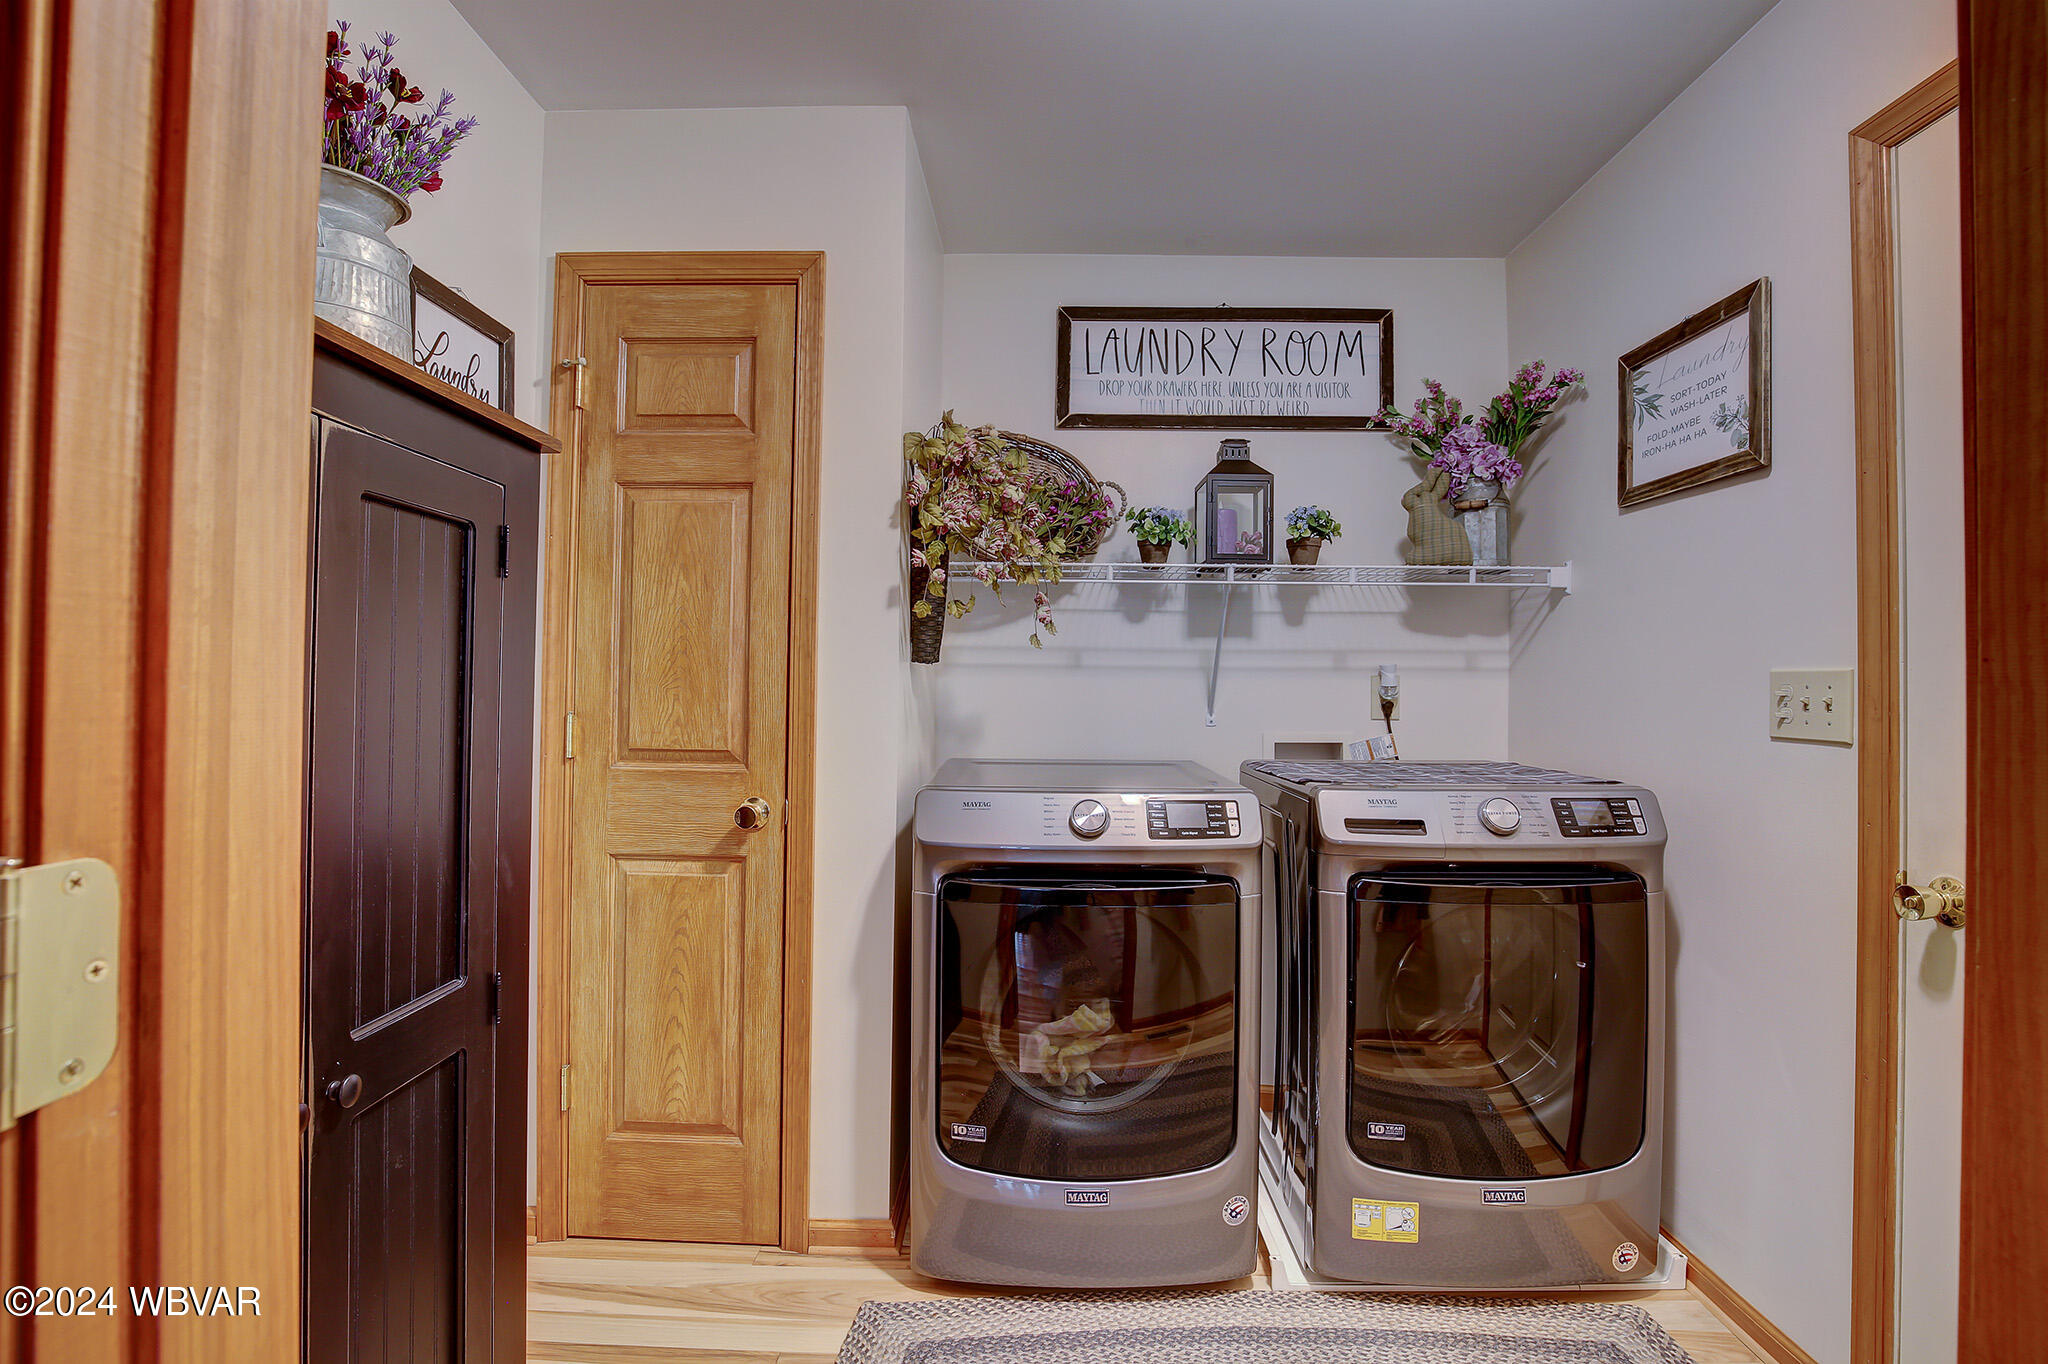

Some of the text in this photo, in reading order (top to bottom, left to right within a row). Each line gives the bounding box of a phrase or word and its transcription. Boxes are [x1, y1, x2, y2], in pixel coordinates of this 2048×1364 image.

[1085, 326, 1366, 377] LAUNDRY ROOM
[1656, 325, 1749, 389] Laundry
[1099, 379, 1352, 399] DROP YOUR DRAWERS HERE. UNLESS YOU ARE A VISITOR
[1670, 370, 1727, 403] SORT-TODAY
[1170, 398, 1181, 415] IT
[1185, 399, 1224, 415] WOULD
[1228, 399, 1256, 415] JUST
[1276, 400, 1310, 416] WEIRD
[1669, 385, 1728, 417] WASH-LATER
[1646, 415, 1702, 444] FOLD-MAYBE
[1641, 427, 1708, 459] IRON-HA HA HA
[953, 1125, 967, 1135] 10
[1370, 1124, 1385, 1134] 10
[1067, 1192, 1107, 1203] MAYTAG
[1484, 1191, 1524, 1201] MAYTAG
